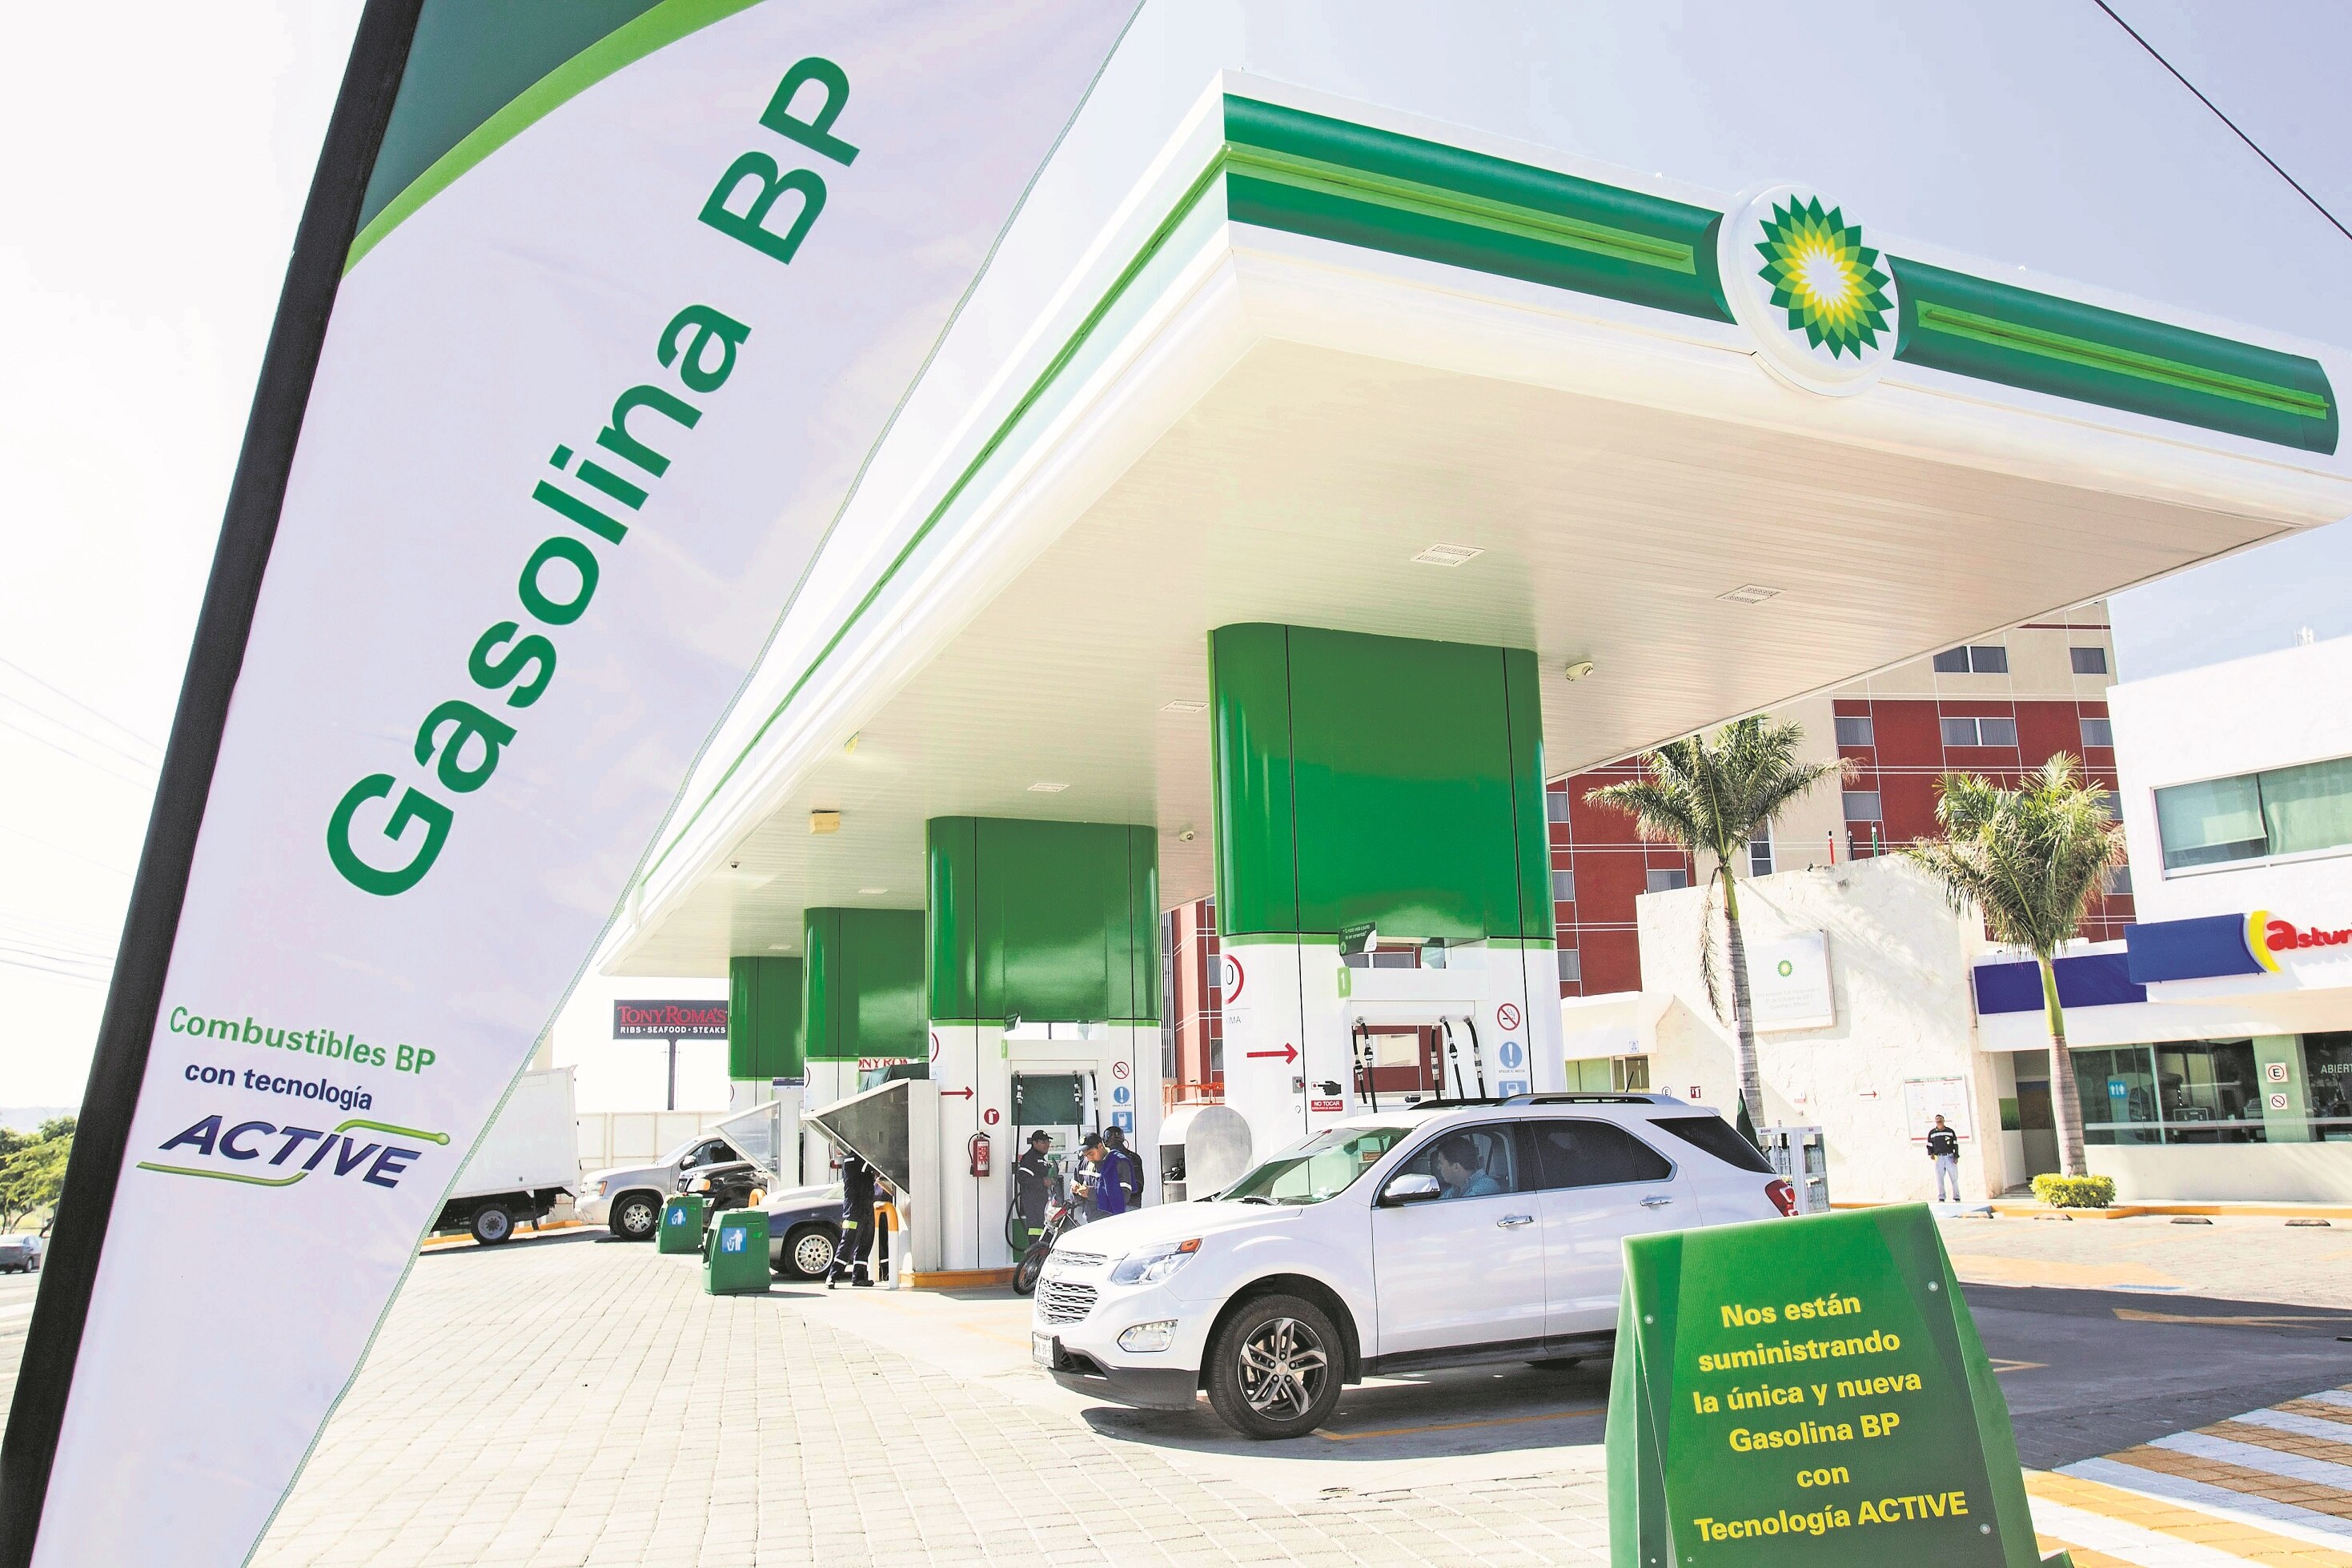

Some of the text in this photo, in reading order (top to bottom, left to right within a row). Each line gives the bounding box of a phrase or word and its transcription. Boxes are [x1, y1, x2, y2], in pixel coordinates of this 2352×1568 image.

[327, 57, 861, 896] Gasolina BP
[1340, 972, 1346, 990] 1
[617, 1005, 726, 1025] TONY ROMA'S
[170, 1006, 436, 1074] Combustibles BP
[186, 1065, 372, 1111] con tecnología
[2273, 1069, 2280, 1077] E
[159, 1115, 422, 1188] ACTIVE
[1721, 1293, 1861, 1328] Nos están
[1699, 1330, 1900, 1372] suministrando
[1694, 1374, 1922, 1414] la única y nueva
[1729, 1413, 1900, 1452] Gasolina BP
[1797, 1466, 1849, 1487] con
[1694, 1491, 1969, 1542] Tecnología ACTIVE
